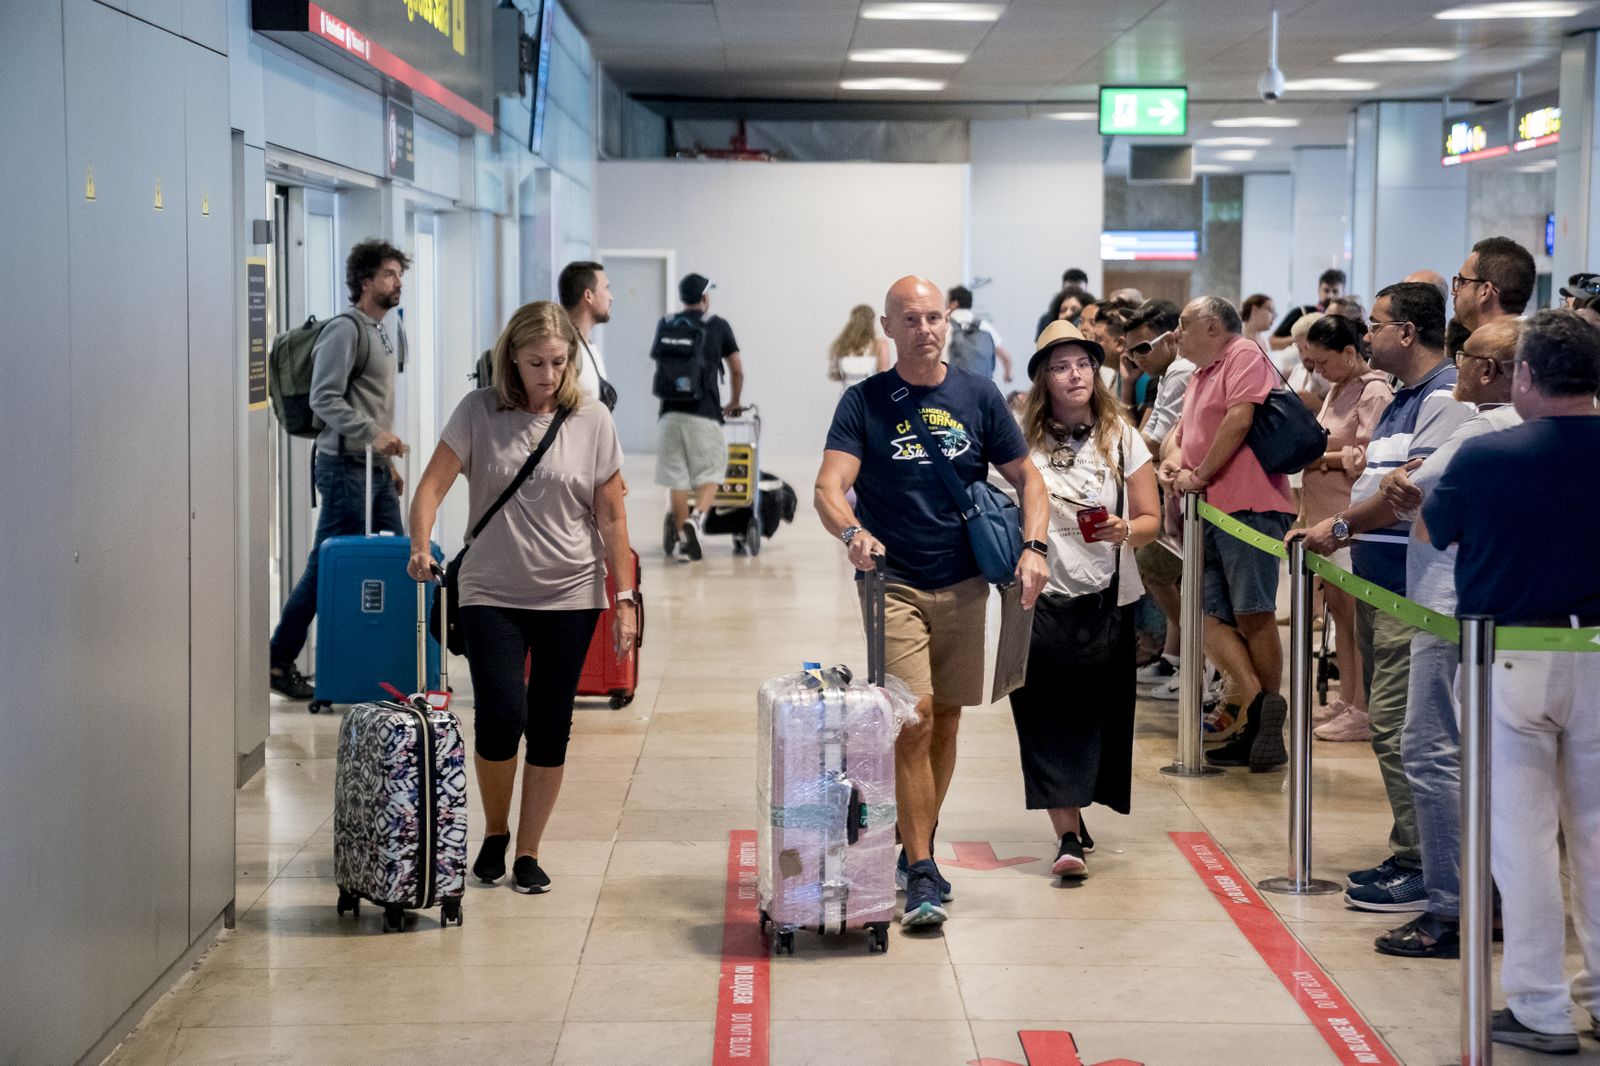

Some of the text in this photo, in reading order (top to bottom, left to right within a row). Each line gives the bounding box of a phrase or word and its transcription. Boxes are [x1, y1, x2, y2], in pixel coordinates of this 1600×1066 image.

[729, 965, 754, 1058] NO BLOQUEAR DO NOT BLOCK
[1291, 971, 1381, 1063] NO BLOQUEAR DO NOT BLOCK
